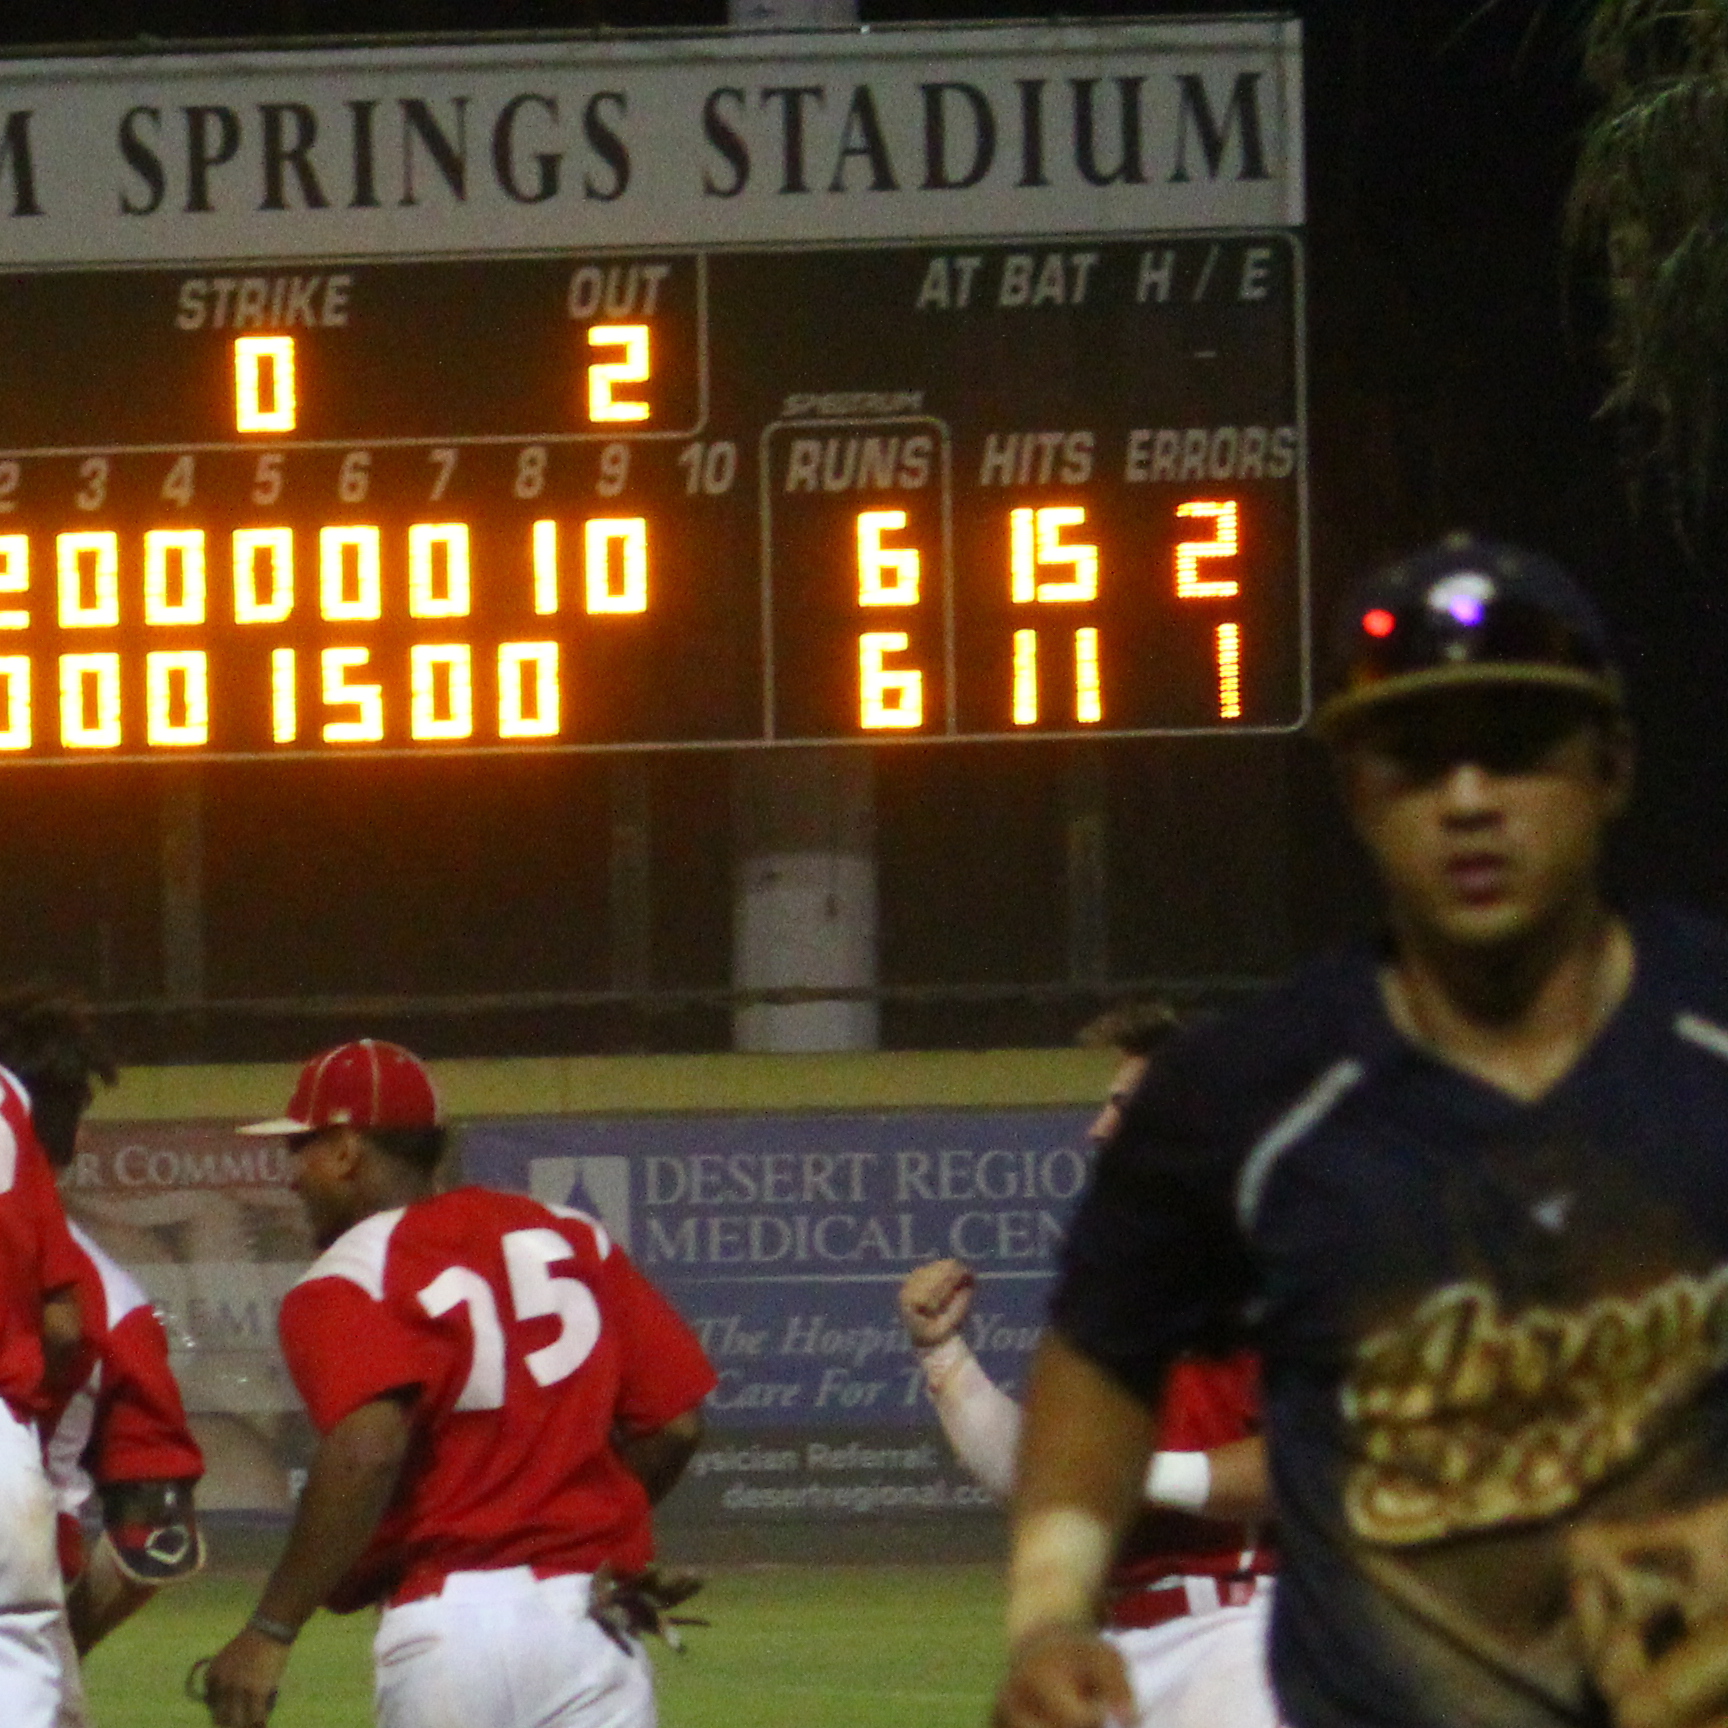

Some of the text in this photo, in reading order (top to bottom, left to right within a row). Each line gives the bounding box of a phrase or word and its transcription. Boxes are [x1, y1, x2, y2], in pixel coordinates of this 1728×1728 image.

[117, 91, 632, 217] SPRINGS
[702, 70, 1272, 197] STADIUM
[175, 274, 352, 330] STRIKE
[566, 264, 669, 319] OUT
[916, 257, 981, 310] AT
[998, 251, 1097, 307] BAT
[233, 335, 298, 433] 0
[587, 324, 651, 423] 2
[76, 458, 109, 511] 3
[161, 455, 195, 508] 4
[252, 453, 286, 505] 5
[339, 451, 370, 503] 6
[428, 448, 456, 500] 7
[514, 445, 546, 497] 8
[597, 443, 629, 496] 9
[680, 440, 735, 494] 10
[785, 425, 1297, 492] RUNS HITS ERRORS
[856, 500, 1239, 607] 6 15 2
[858, 622, 1241, 729] 6 11 1
[644, 1146, 1096, 1205] DESERT REGIO
[644, 1213, 940, 1263] MEDICAL
[696, 1314, 769, 1356] The
[814, 1367, 889, 1408] For
